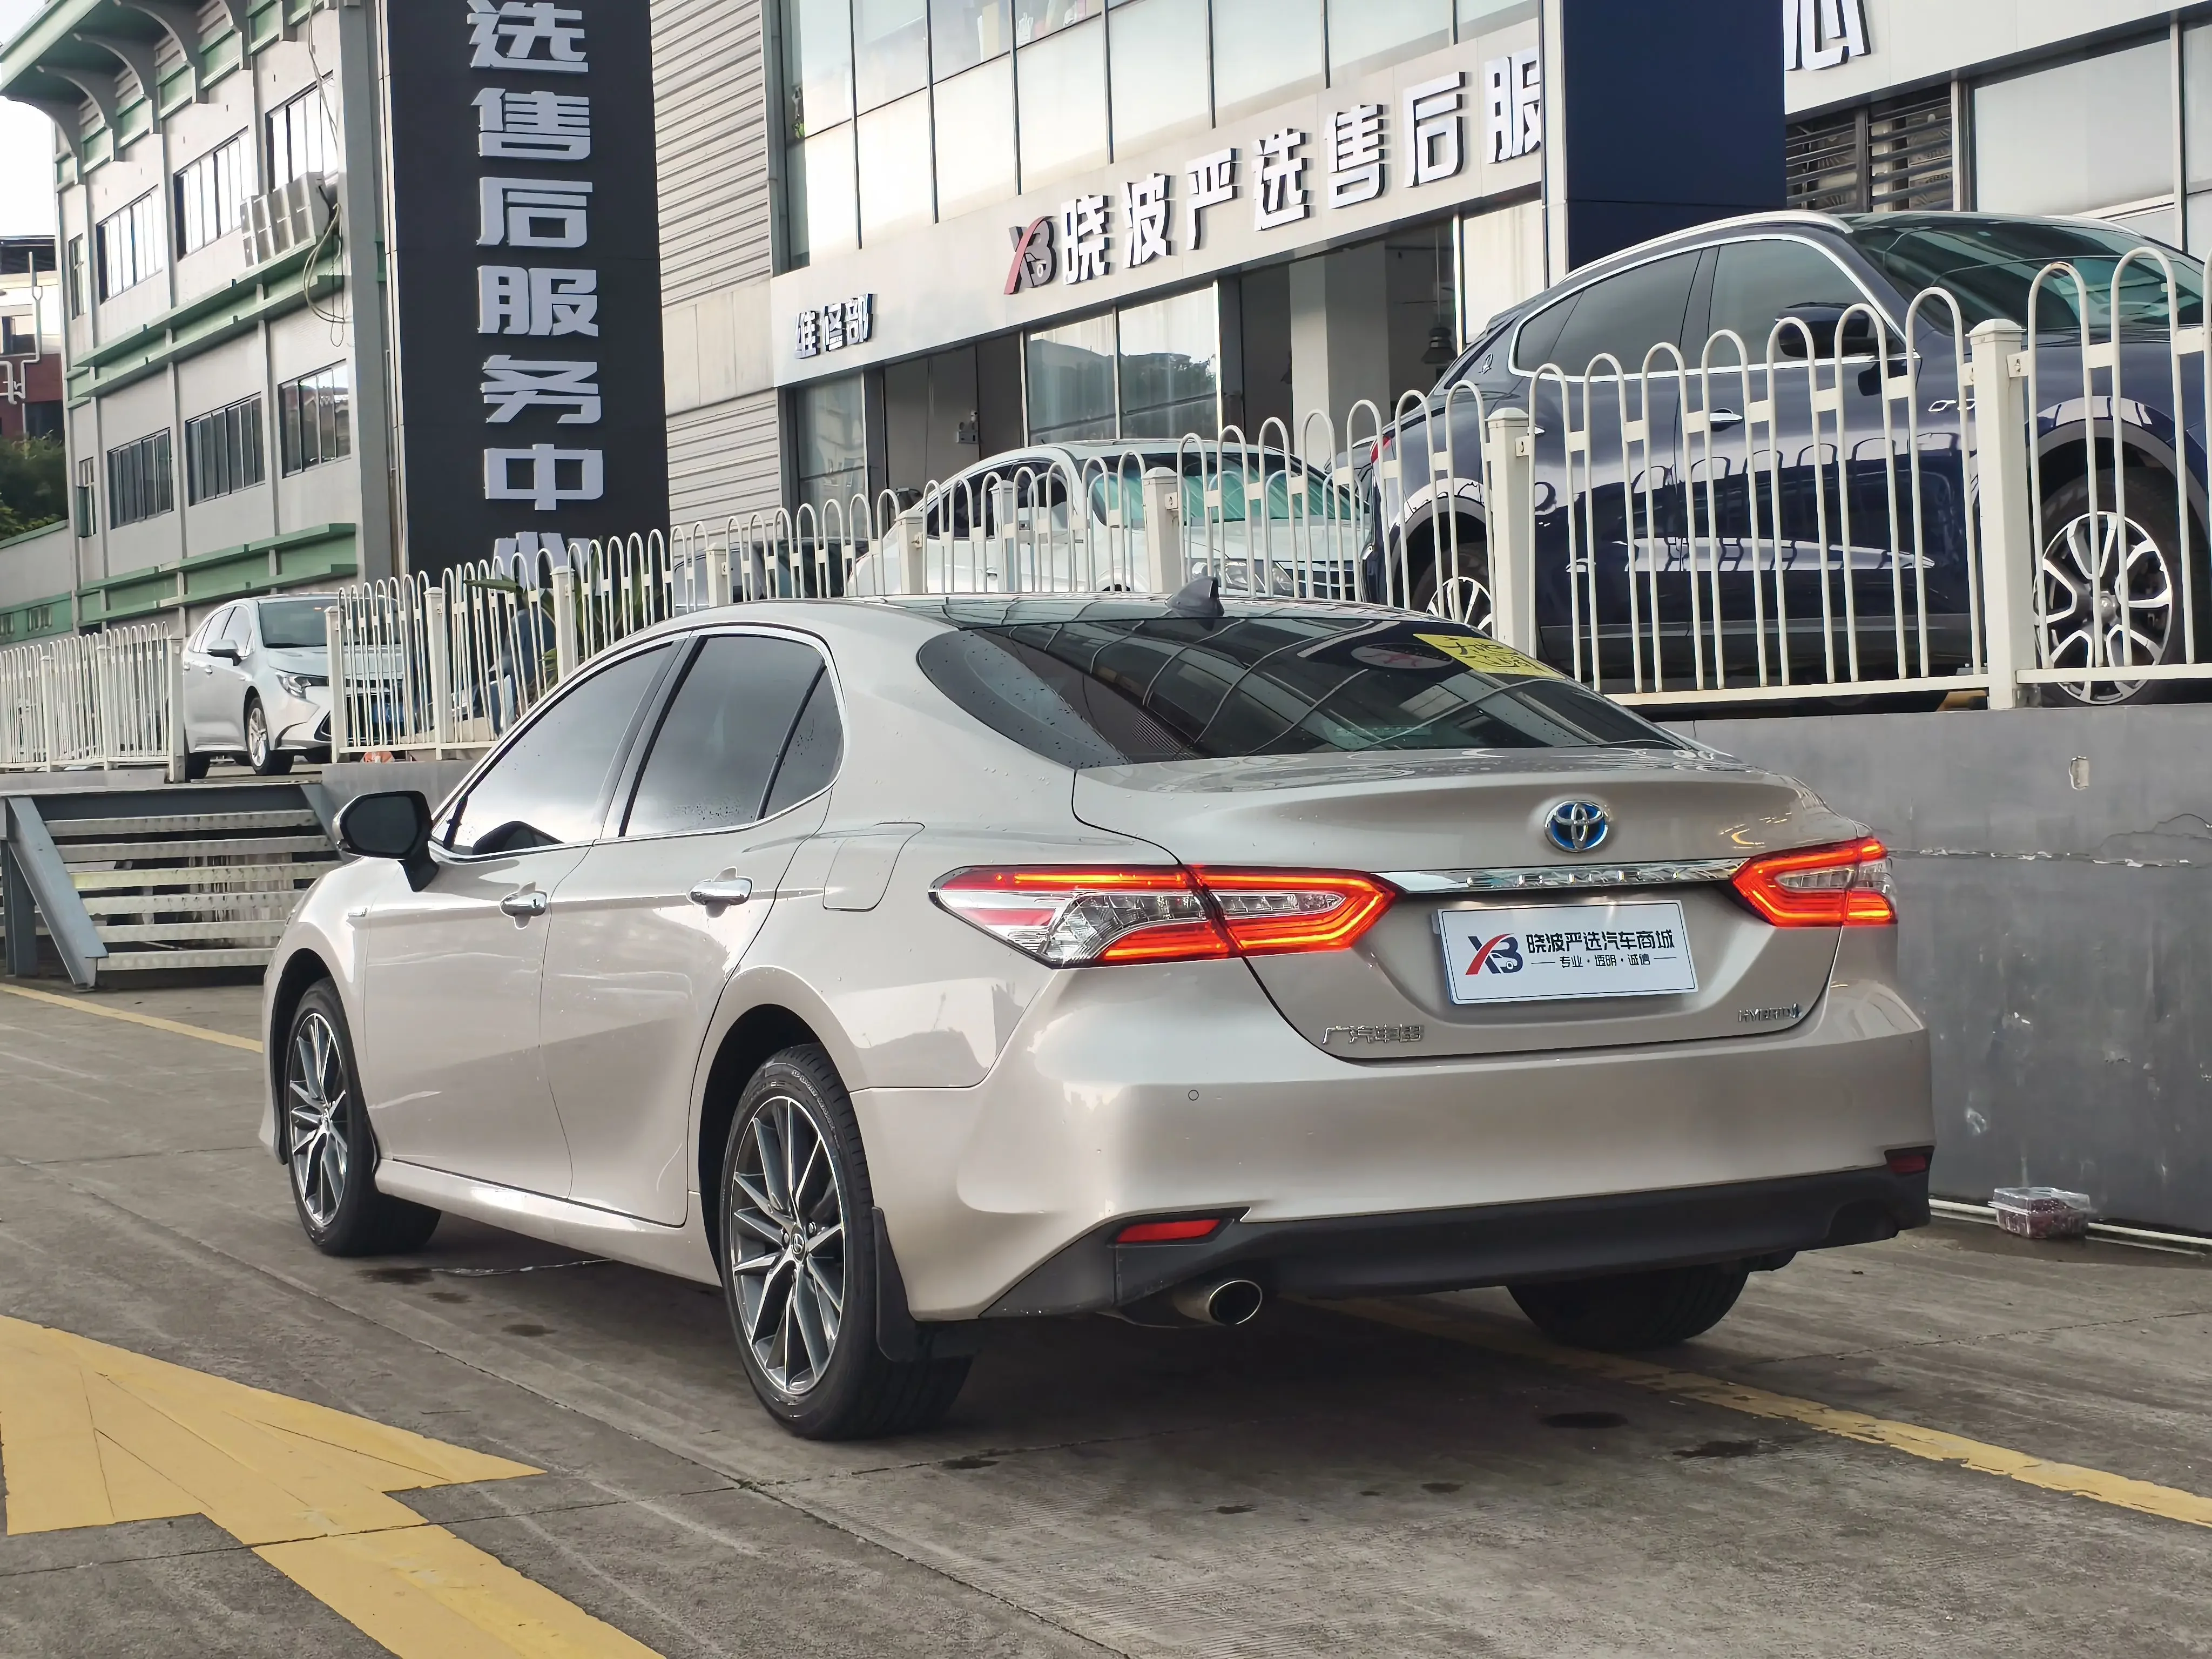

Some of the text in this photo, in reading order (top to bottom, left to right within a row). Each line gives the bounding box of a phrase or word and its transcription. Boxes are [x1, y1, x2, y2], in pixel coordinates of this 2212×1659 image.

[1061, 46, 1541, 285] 晓波严选售后服
[1526, 930, 1675, 953] 晓波严选汽车商城
